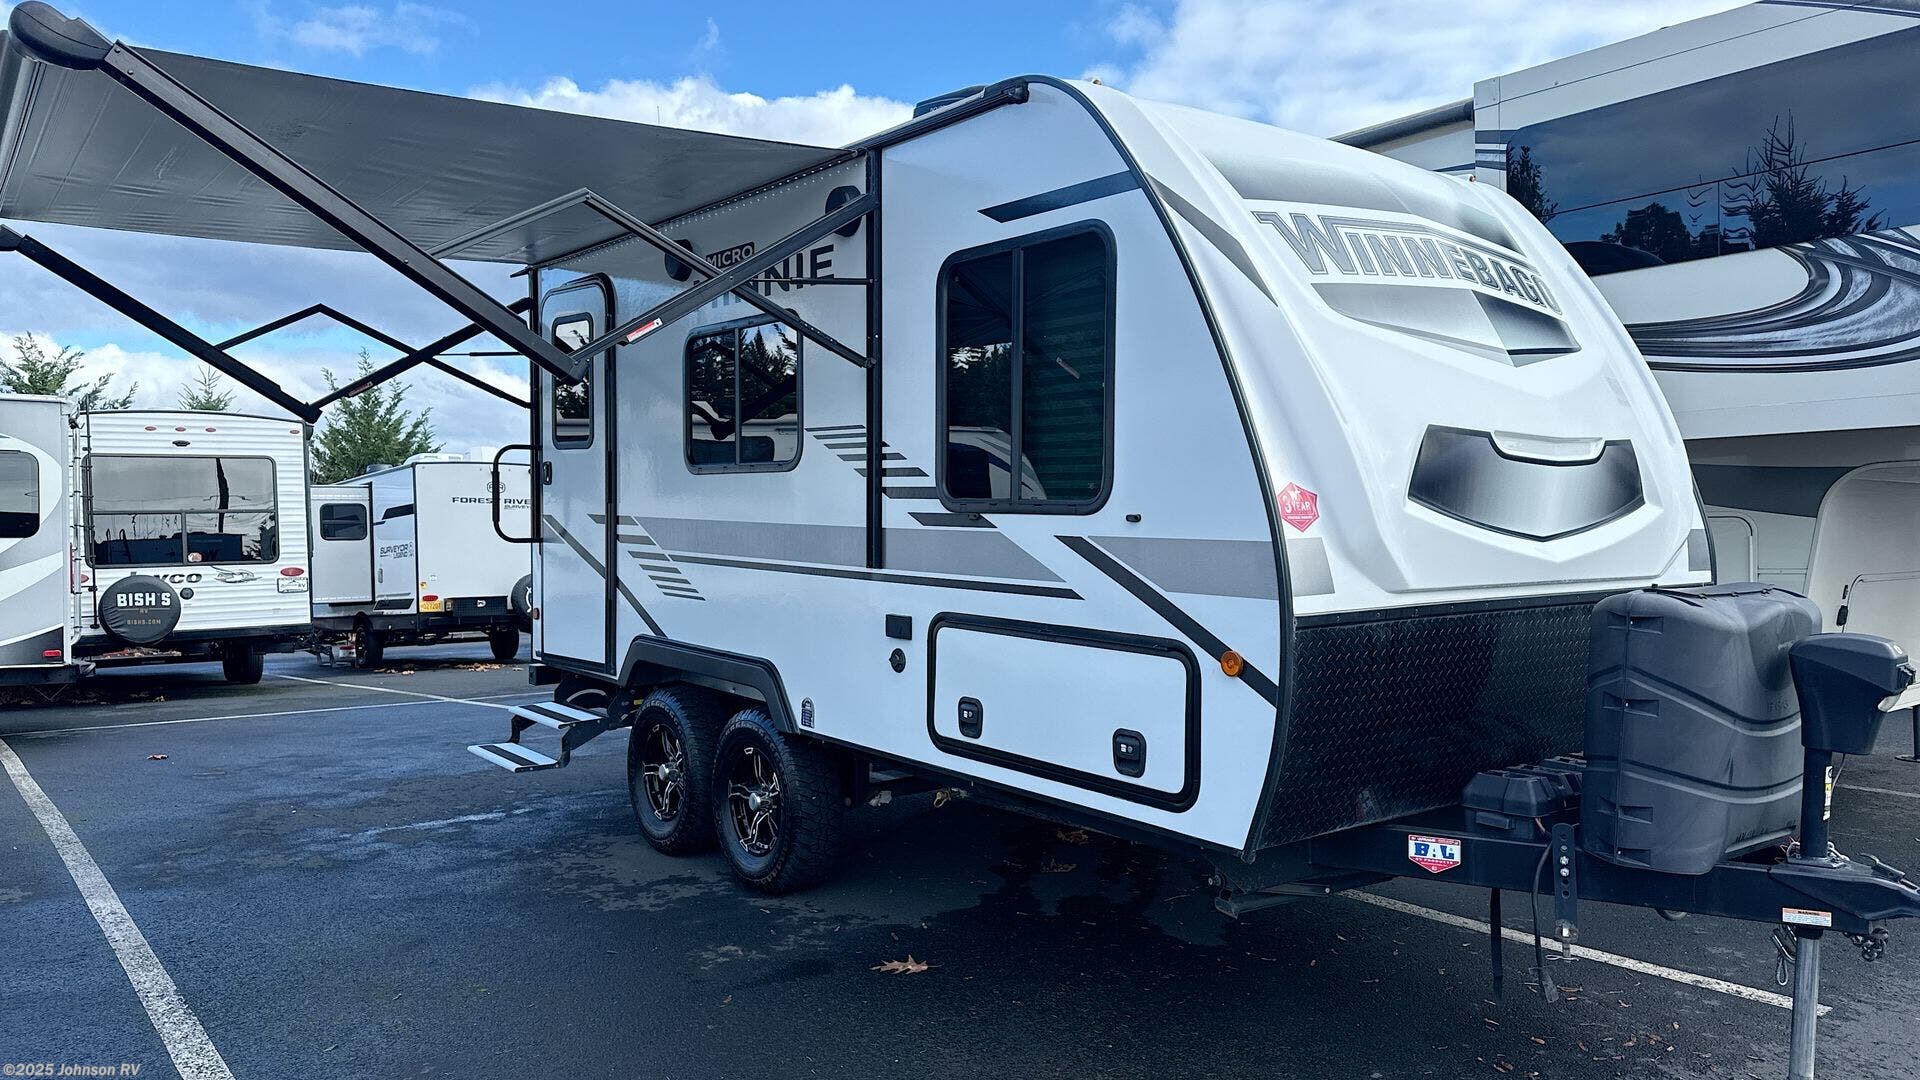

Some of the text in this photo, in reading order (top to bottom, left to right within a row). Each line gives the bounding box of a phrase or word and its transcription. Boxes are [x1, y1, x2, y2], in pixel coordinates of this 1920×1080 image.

[707, 245, 753, 267] MICRO
[1251, 211, 1562, 315] WINNEBAGO
[1293, 501, 1311, 511] YEAR
[117, 593, 171, 607] BISH'S
[1415, 842, 1455, 860] BAL
